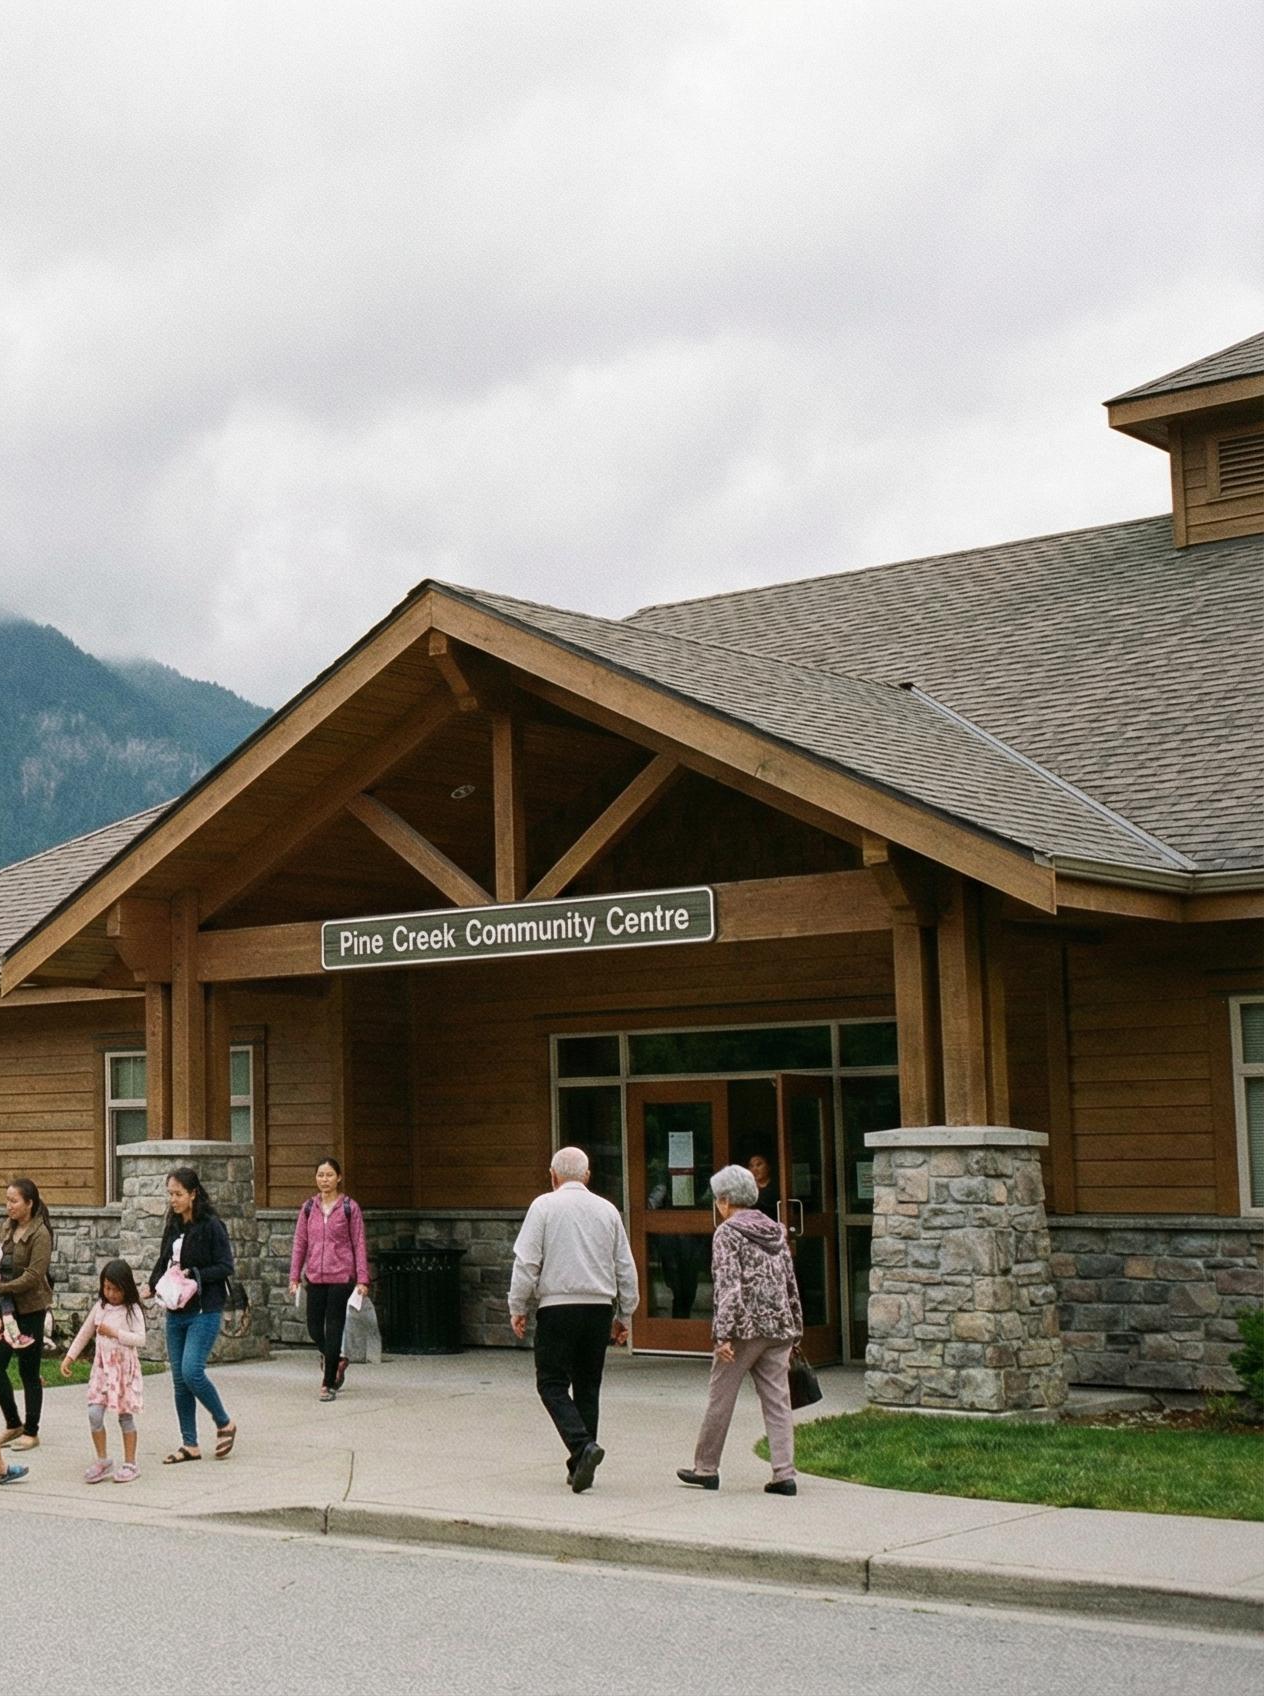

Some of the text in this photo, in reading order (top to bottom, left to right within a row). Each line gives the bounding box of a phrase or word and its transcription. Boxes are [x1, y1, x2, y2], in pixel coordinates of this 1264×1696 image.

[340, 904, 690, 957] Pine Creek Community Centre
